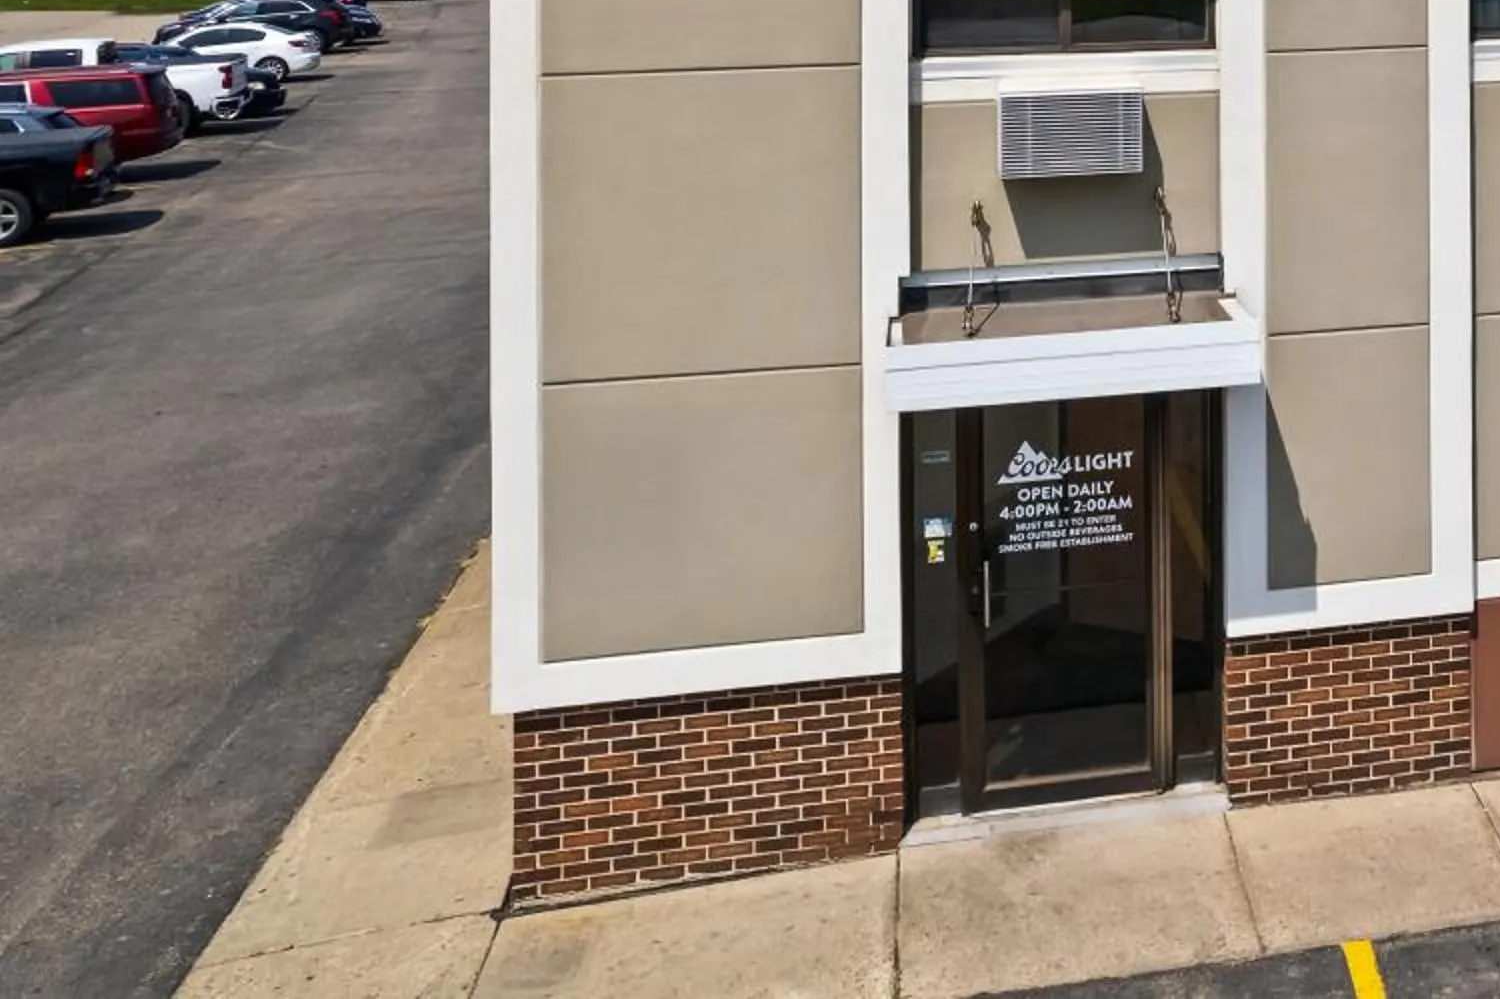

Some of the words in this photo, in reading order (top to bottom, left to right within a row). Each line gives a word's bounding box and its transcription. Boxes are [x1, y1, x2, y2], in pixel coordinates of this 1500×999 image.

[1074, 451, 1134, 473] LIGHT
[1017, 485, 1063, 501] OPEN
[1068, 481, 1114, 498] DAILY
[1000, 503, 1060, 520] 4:00PM
[1073, 496, 1133, 514] 2:00AM
[1009, 532, 1025, 542] NO
[1026, 529, 1067, 540] OUTSIDE
[1069, 524, 1123, 536] BEVERAGES
[1015, 520, 1041, 532] MUST
[1071, 517, 1084, 526] TO
[1086, 514, 1117, 525] ENTER
[998, 542, 1033, 554] SMOKE
[1060, 532, 1134, 548] ESTABLISHMENT
